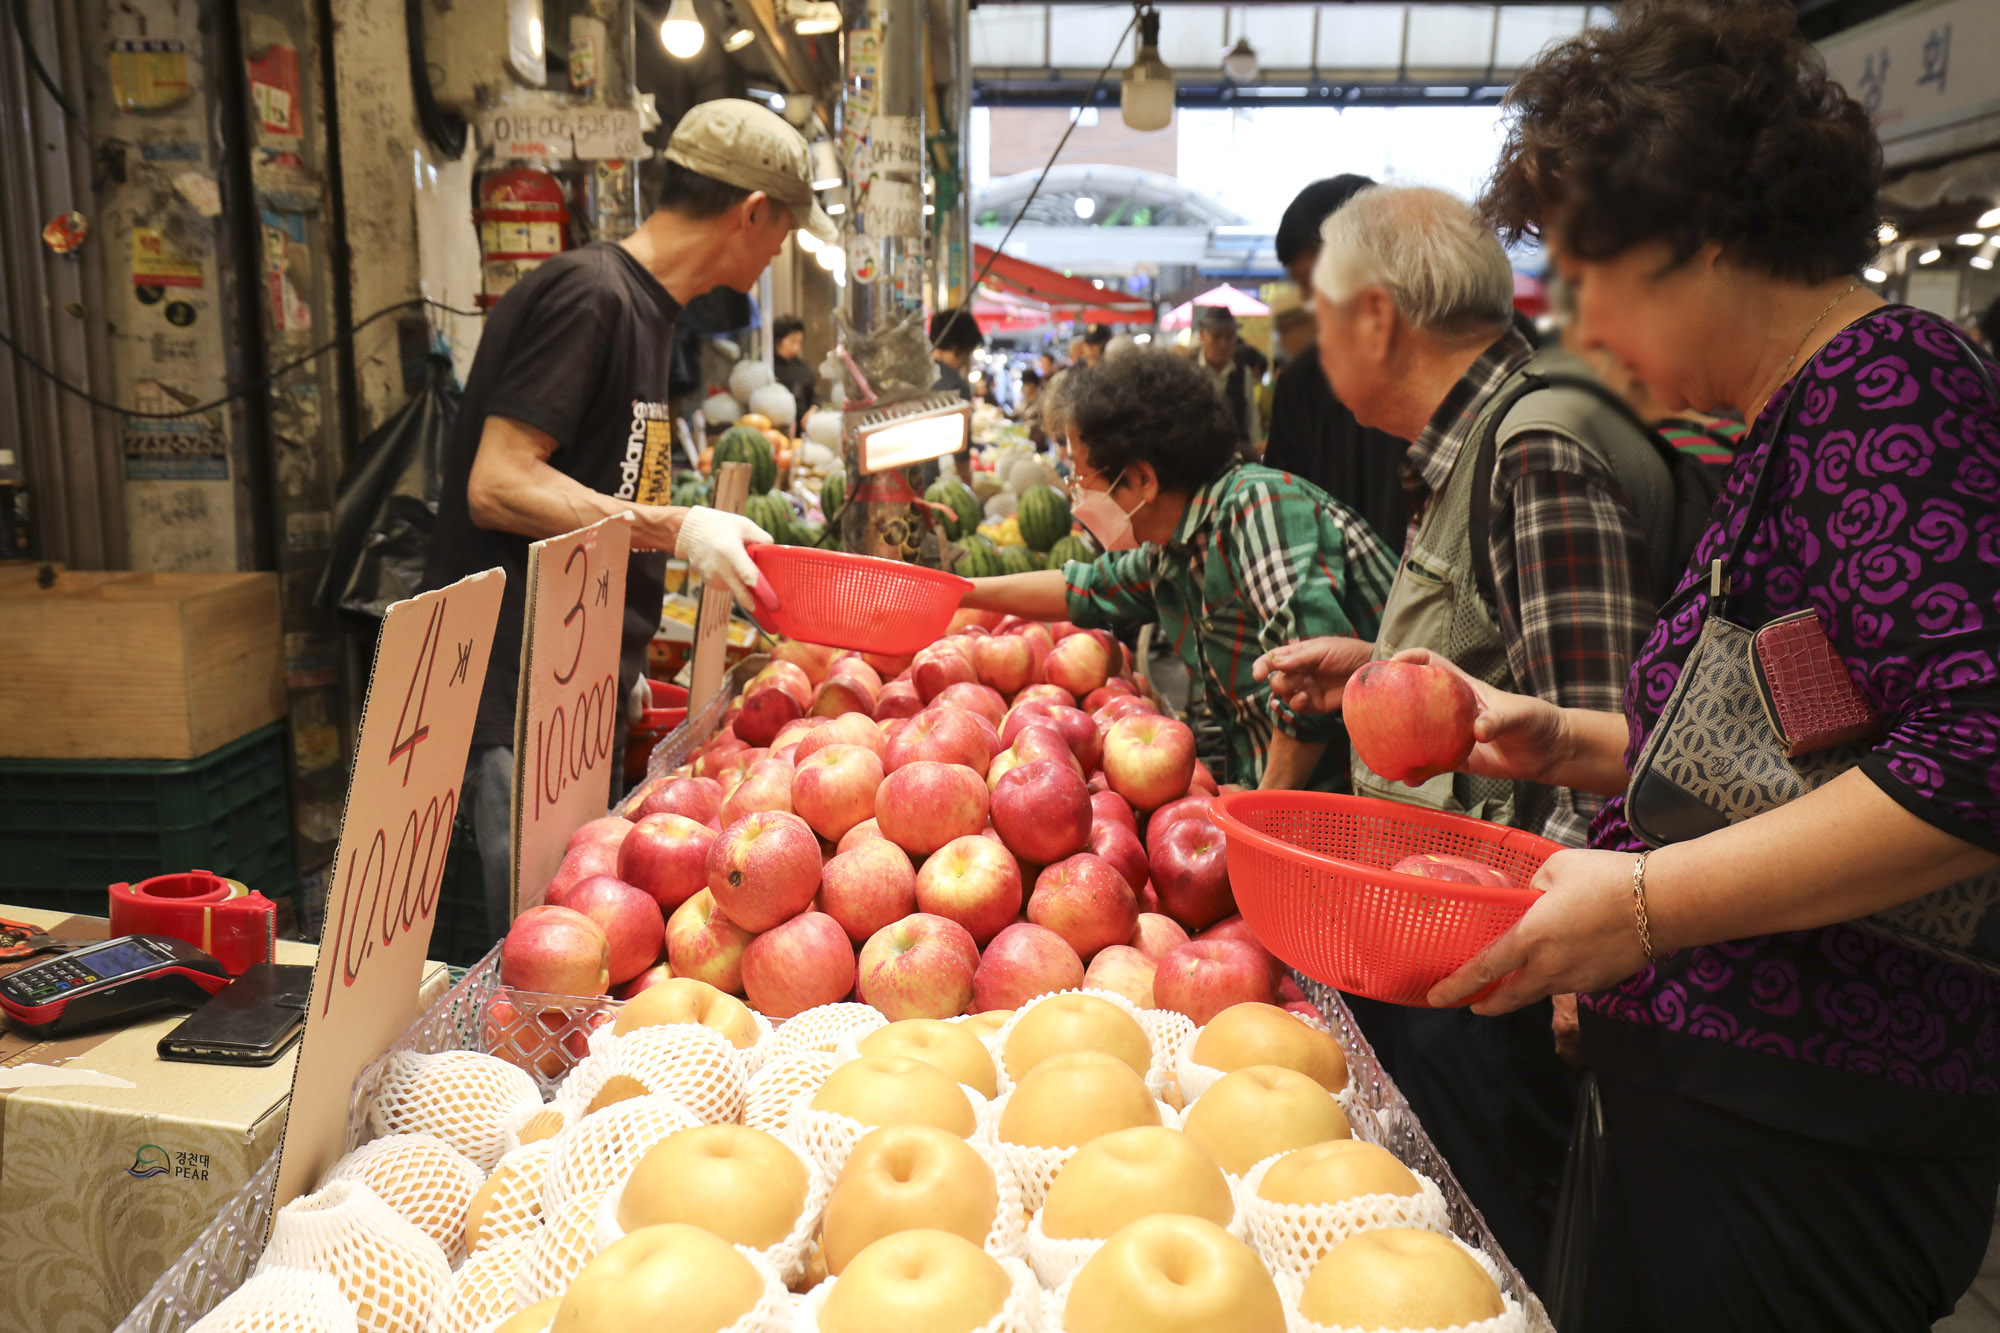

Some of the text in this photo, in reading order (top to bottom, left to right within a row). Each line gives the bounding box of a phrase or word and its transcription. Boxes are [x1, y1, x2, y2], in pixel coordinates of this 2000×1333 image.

[613, 401, 648, 500] balance
[553, 543, 588, 686] 3
[388, 597, 447, 788] 4
[535, 673, 615, 822] 10.000
[322, 787, 455, 1020] 10.000
[175, 1151, 210, 1168] 경천대
[175, 1166, 209, 1181] PEAR
